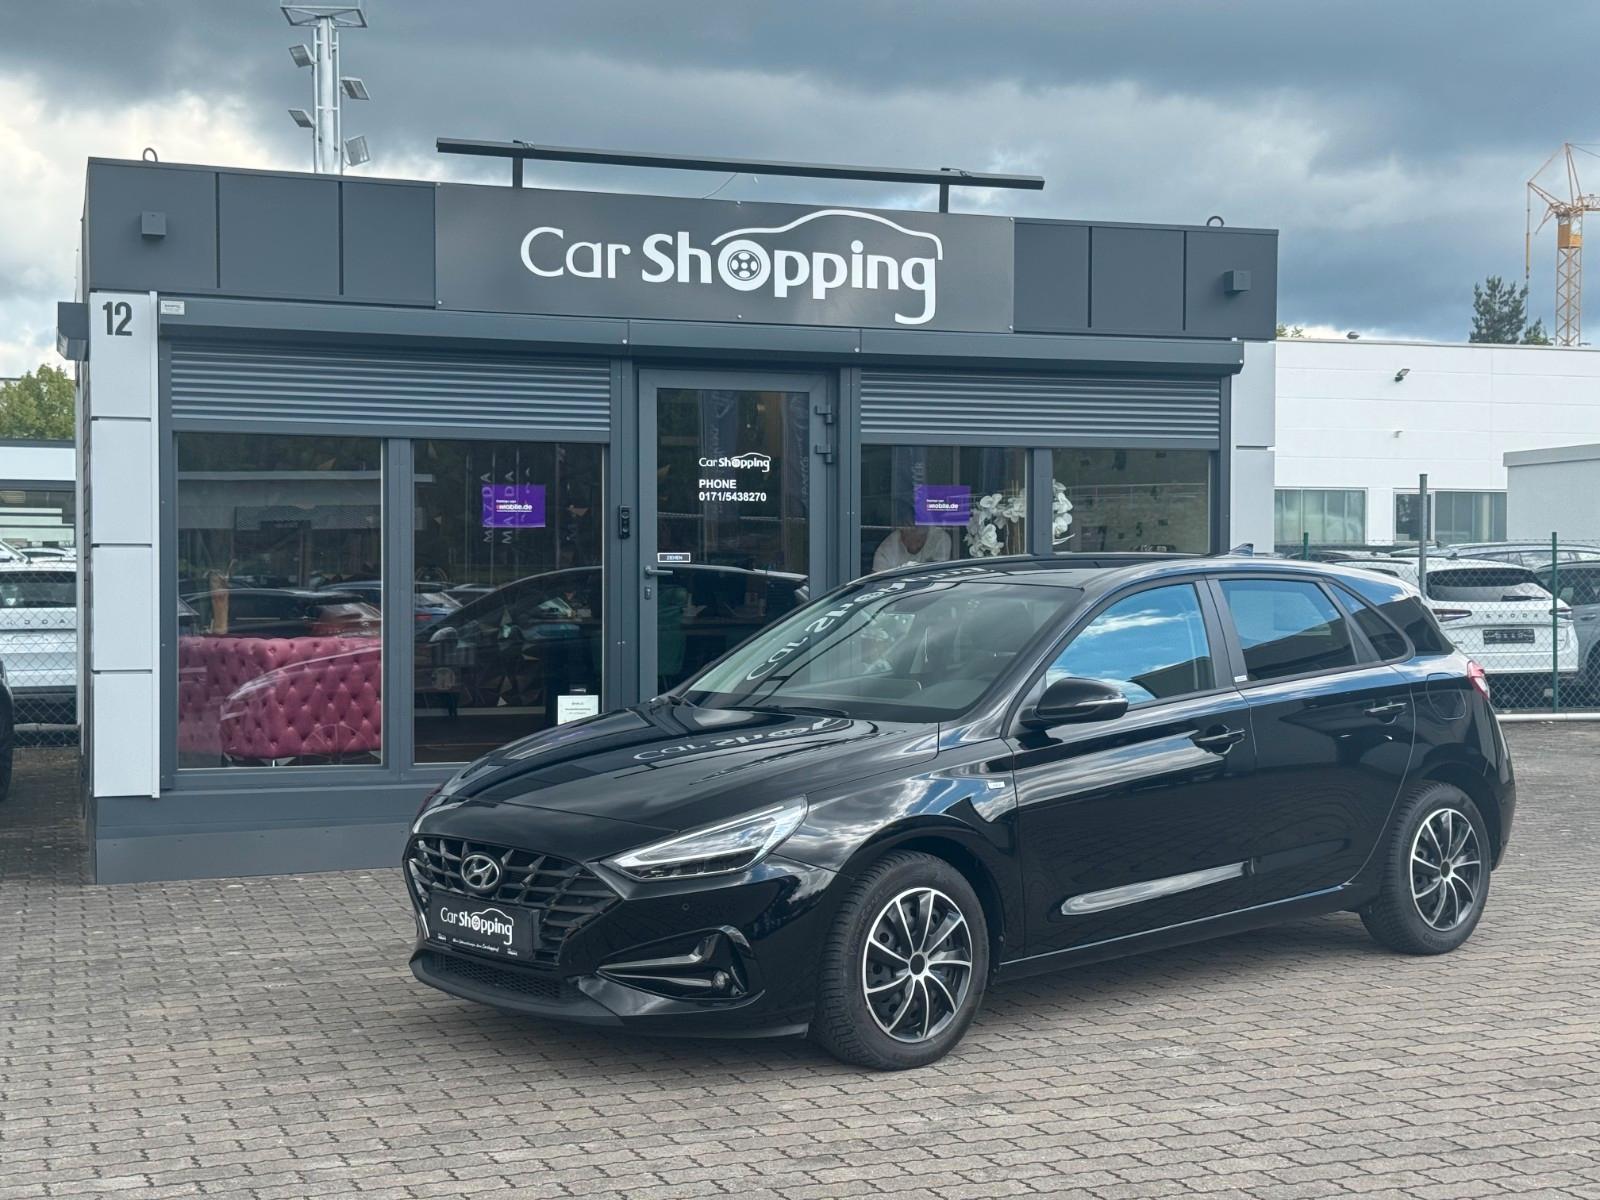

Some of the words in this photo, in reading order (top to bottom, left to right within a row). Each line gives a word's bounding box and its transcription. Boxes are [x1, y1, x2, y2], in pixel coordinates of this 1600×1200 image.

[520, 226, 631, 280] Car
[642, 231, 937, 325] Shopping
[103, 301, 132, 336] 12
[699, 457, 717, 467] Car
[718, 457, 770, 473] Shopping
[698, 491, 767, 502] 0171/5438270
[699, 479, 737, 489] PHONE
[440, 907, 458, 924] Car
[458, 911, 513, 946] Shopping
